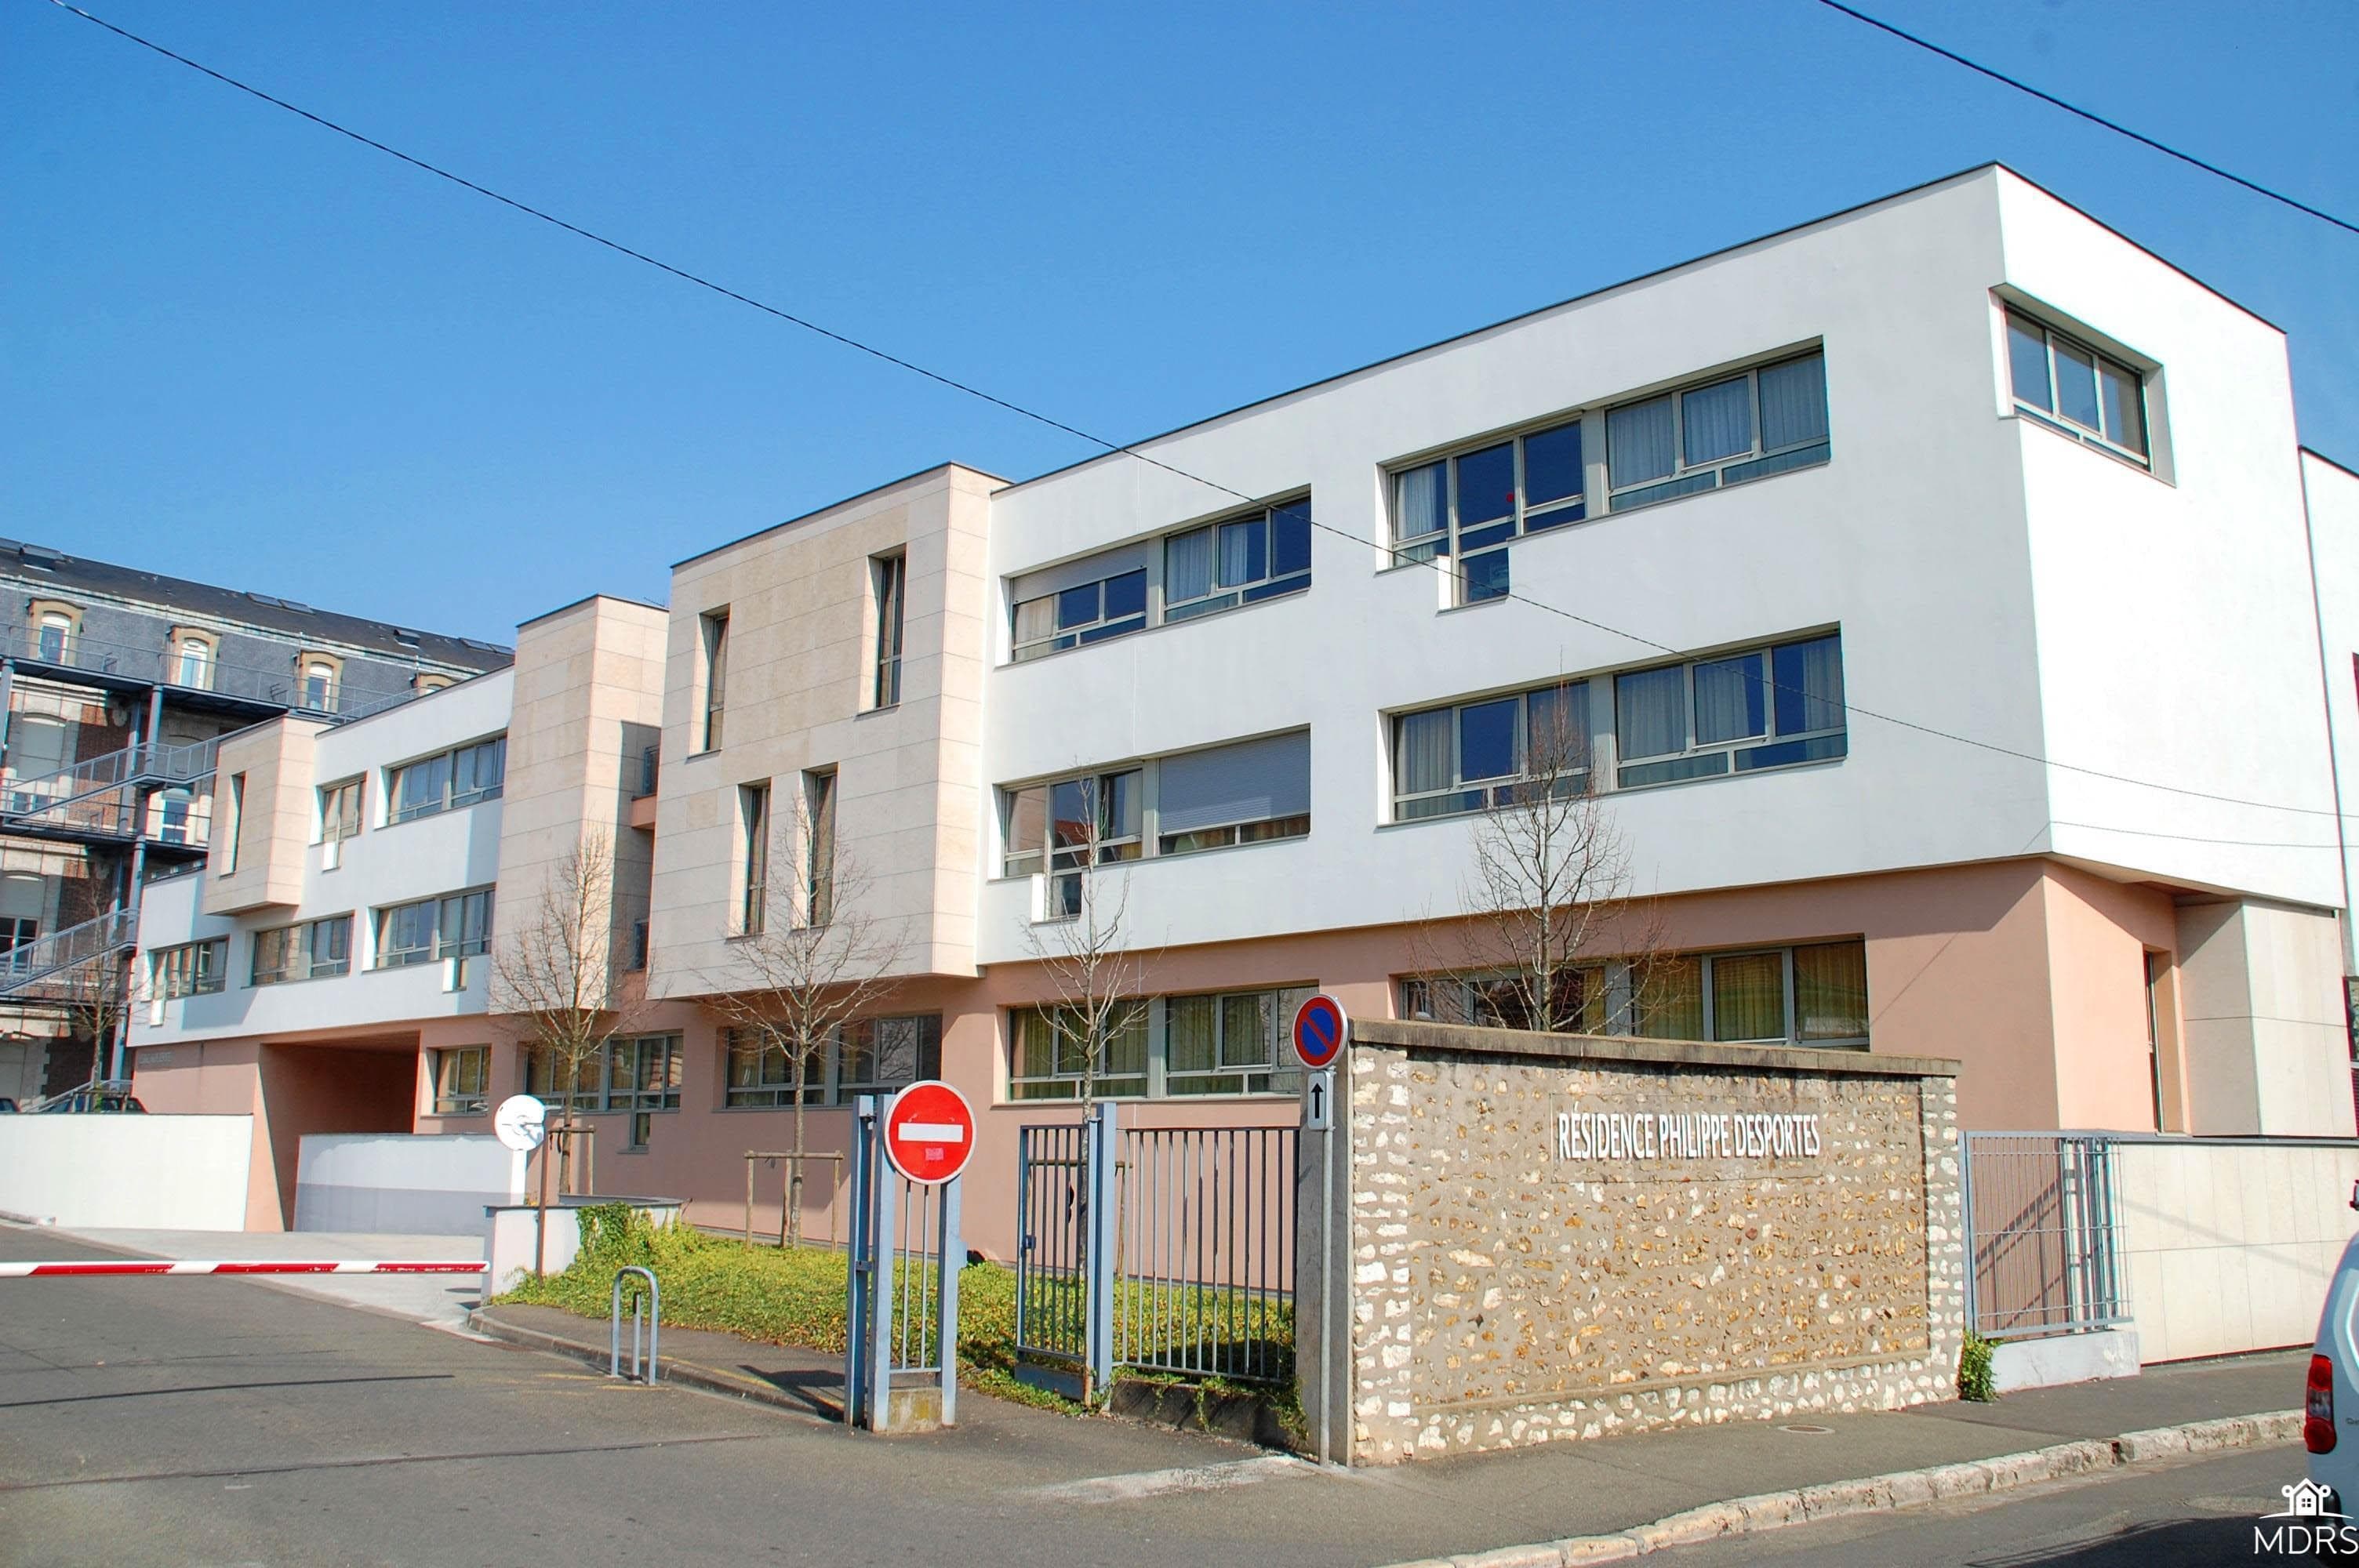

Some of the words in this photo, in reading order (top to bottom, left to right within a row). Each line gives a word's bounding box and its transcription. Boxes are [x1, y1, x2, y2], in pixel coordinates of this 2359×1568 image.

[1558, 1101, 1655, 1160] RÉSIDENCE
[1659, 1113, 1731, 1158] PHILIPPE
[1734, 1113, 1820, 1156] DESPORTES
